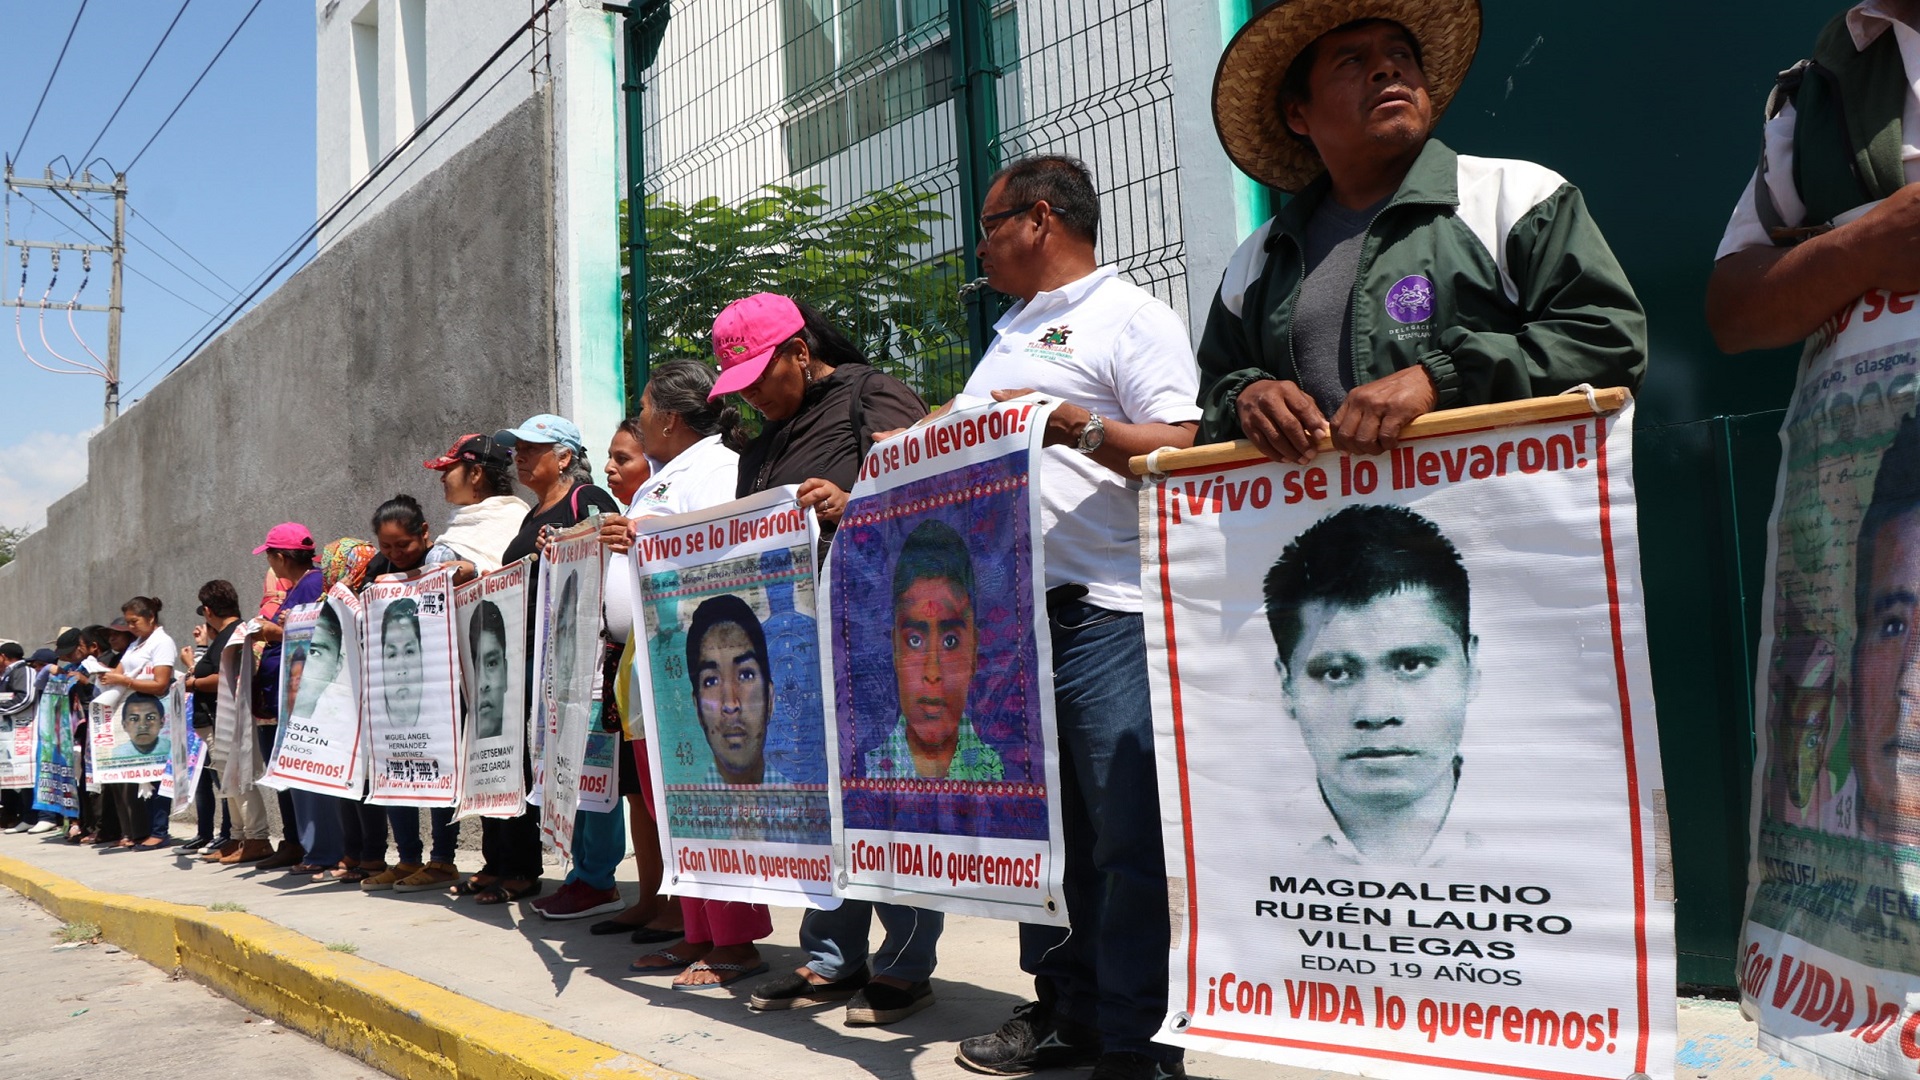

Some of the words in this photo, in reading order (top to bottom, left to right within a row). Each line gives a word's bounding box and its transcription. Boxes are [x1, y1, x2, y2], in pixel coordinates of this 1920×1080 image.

[1854, 351, 1917, 376] Glasgow,
[883, 444, 899, 474] se
[903, 435, 920, 467] lo
[925, 404, 1033, 459] llevaron!
[1171, 475, 1272, 525] ¡Vivo
[1283, 467, 1328, 504] se
[1340, 456, 1378, 496] lo
[1391, 424, 1588, 491] llevaron!
[638, 534, 682, 567] ¡Vivo
[686, 530, 704, 554] se
[708, 524, 724, 550] lo
[729, 508, 806, 546] llevaron!
[389, 585, 401, 598] se
[485, 567, 523, 595] llevaron!
[121, 770, 141, 780] VIDA
[143, 769, 151, 778] lo
[278, 754, 345, 778] queremos!
[678, 846, 707, 873] ¡Con
[708, 848, 742, 874] VIDA
[742, 850, 757, 875] lo
[759, 855, 832, 882] queremos!
[851, 840, 885, 874] ¡Con
[888, 842, 924, 876] VIDA
[928, 844, 943, 879] lo
[947, 852, 1041, 889] queremos!
[1270, 876, 1551, 905] MAGDALENO
[1255, 900, 1391, 927] RUBÉN
[1408, 909, 1572, 935] LAURO
[1298, 928, 1516, 960] VILLEGAS
[1301, 954, 1376, 975] EDAD
[1390, 962, 1422, 978] 19
[1433, 962, 1522, 986] AÑOS
[1206, 972, 1273, 1016] ¡Con
[1284, 979, 1365, 1026] VIDA
[1374, 986, 1406, 1030] lo
[1417, 997, 1618, 1054] queremos!
[1772, 954, 1855, 1033] VIDA
[1850, 985, 1901, 1044] lo
